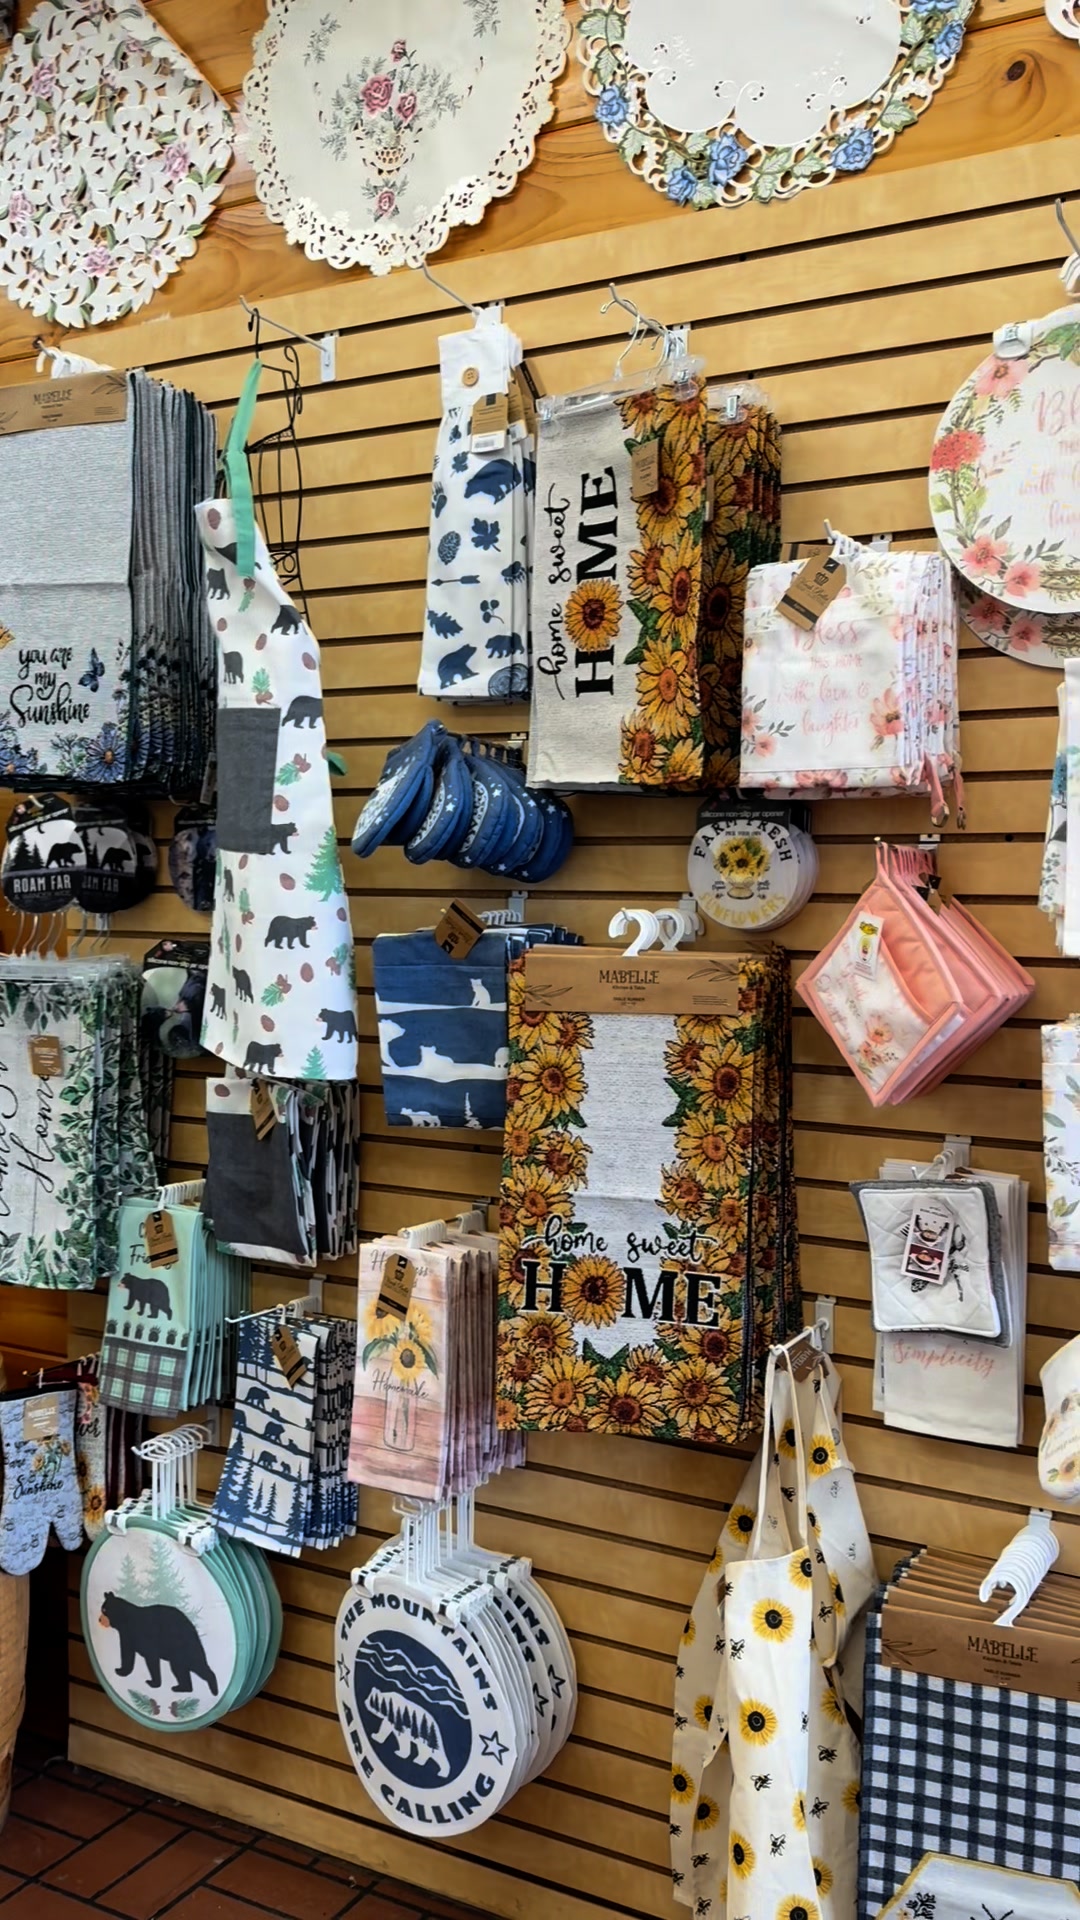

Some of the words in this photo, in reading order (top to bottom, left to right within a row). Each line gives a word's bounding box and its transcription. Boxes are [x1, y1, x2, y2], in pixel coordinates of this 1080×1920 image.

[544, 483, 571, 585] sweet
[18, 649, 48, 680] you
[50, 647, 74, 670] are
[537, 603, 568, 700] home
[10, 681, 90, 728] Sunshine
[35, 671, 57, 701] my
[13, 876, 47, 893] ROAM
[51, 873, 72, 890] FAR
[599, 969, 660, 985] MABELLE
[522, 1215, 608, 1256] home
[627, 1231, 718, 1262] sweet
[893, 1338, 995, 1378] Simplicity
[372, 1368, 430, 1400] Homemade
[340, 1599, 366, 1641] THE
[371, 1593, 498, 1711] MOUNTAINS
[967, 1635, 1039, 1663] MABELLE
[342, 1700, 374, 1779] ARE
[379, 1772, 496, 1824] CALLING
